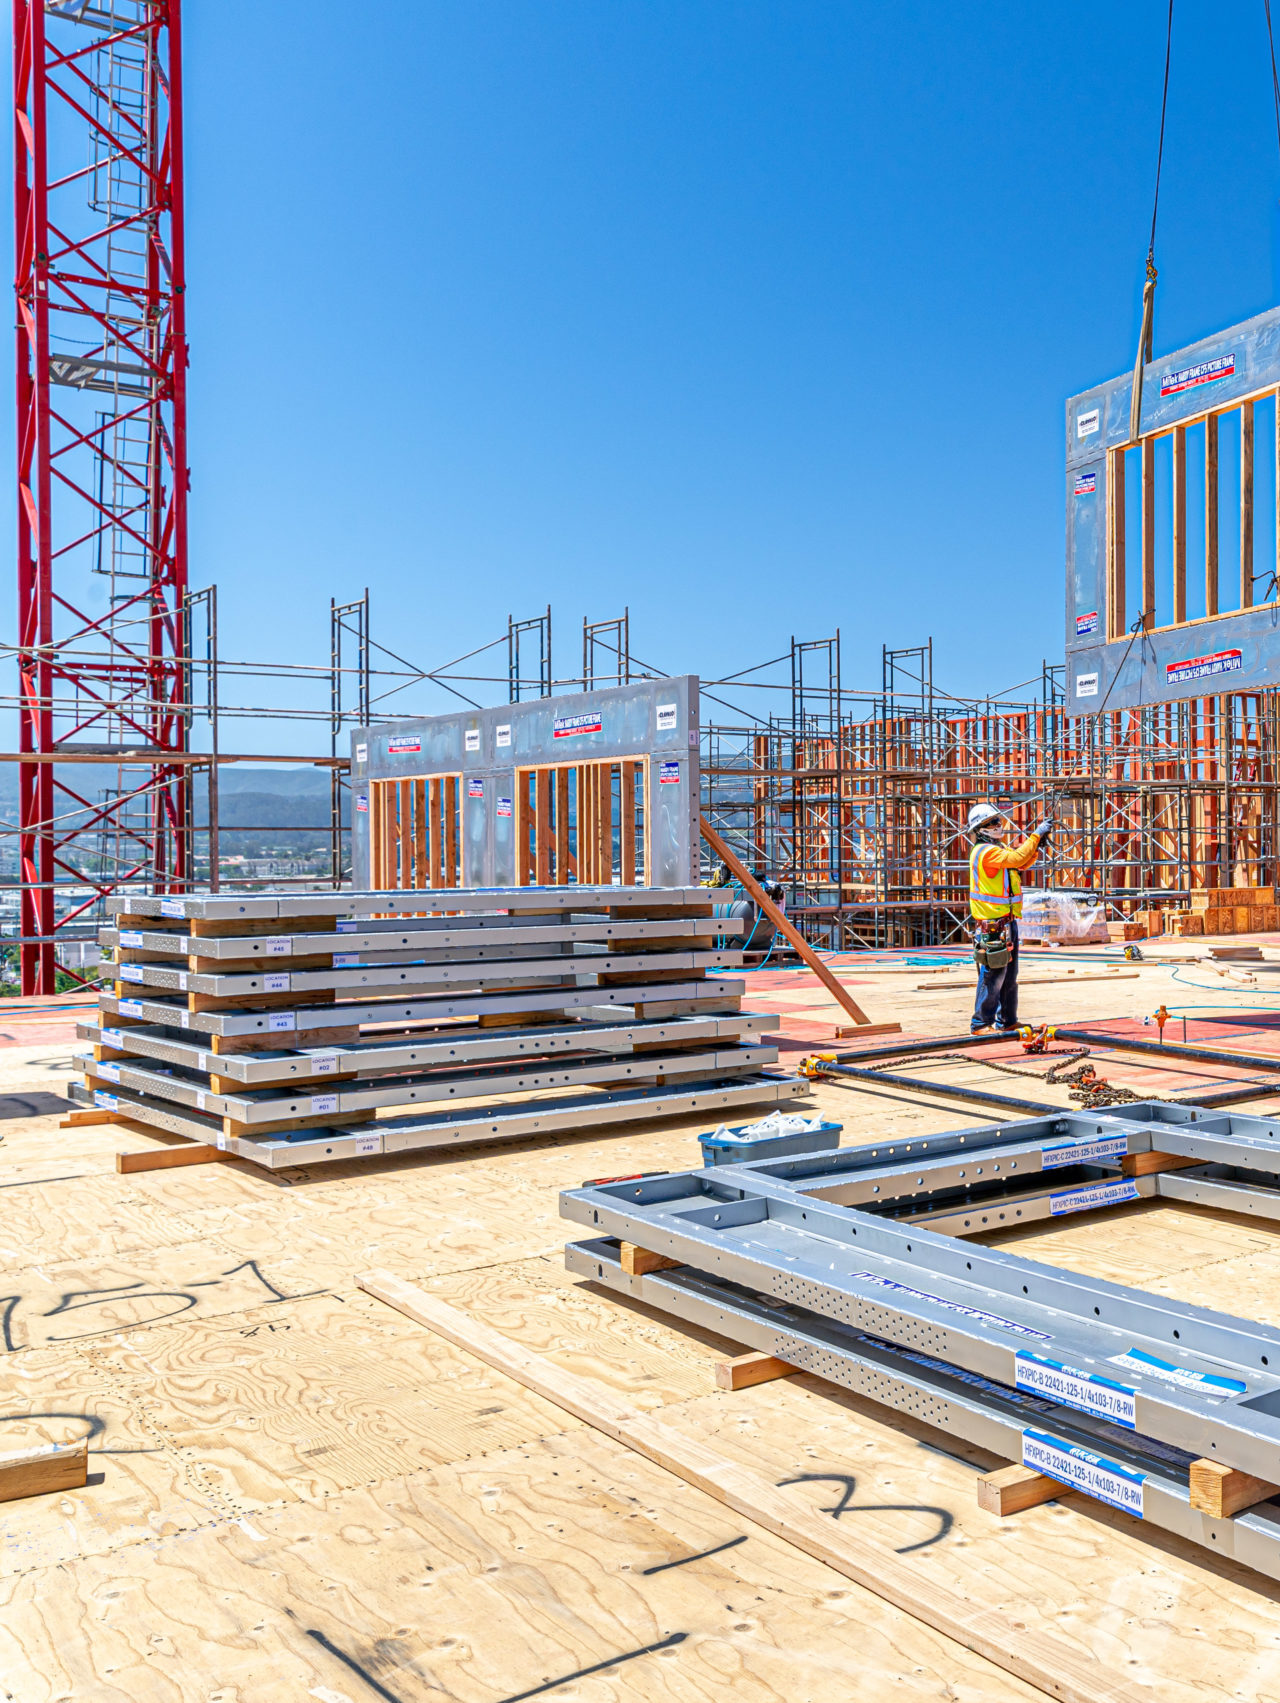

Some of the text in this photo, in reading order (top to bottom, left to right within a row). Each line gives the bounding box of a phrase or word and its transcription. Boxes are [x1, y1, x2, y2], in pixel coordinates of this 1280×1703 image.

[1017, 1364, 1044, 1387] HFXPIC-B
[1044, 1373, 1134, 1418] 22421-125-1/4x103-7/8-RW
[1023, 1442, 1142, 1506] HFXPIC-B 22421-125-1/4x103-7/8-RW
